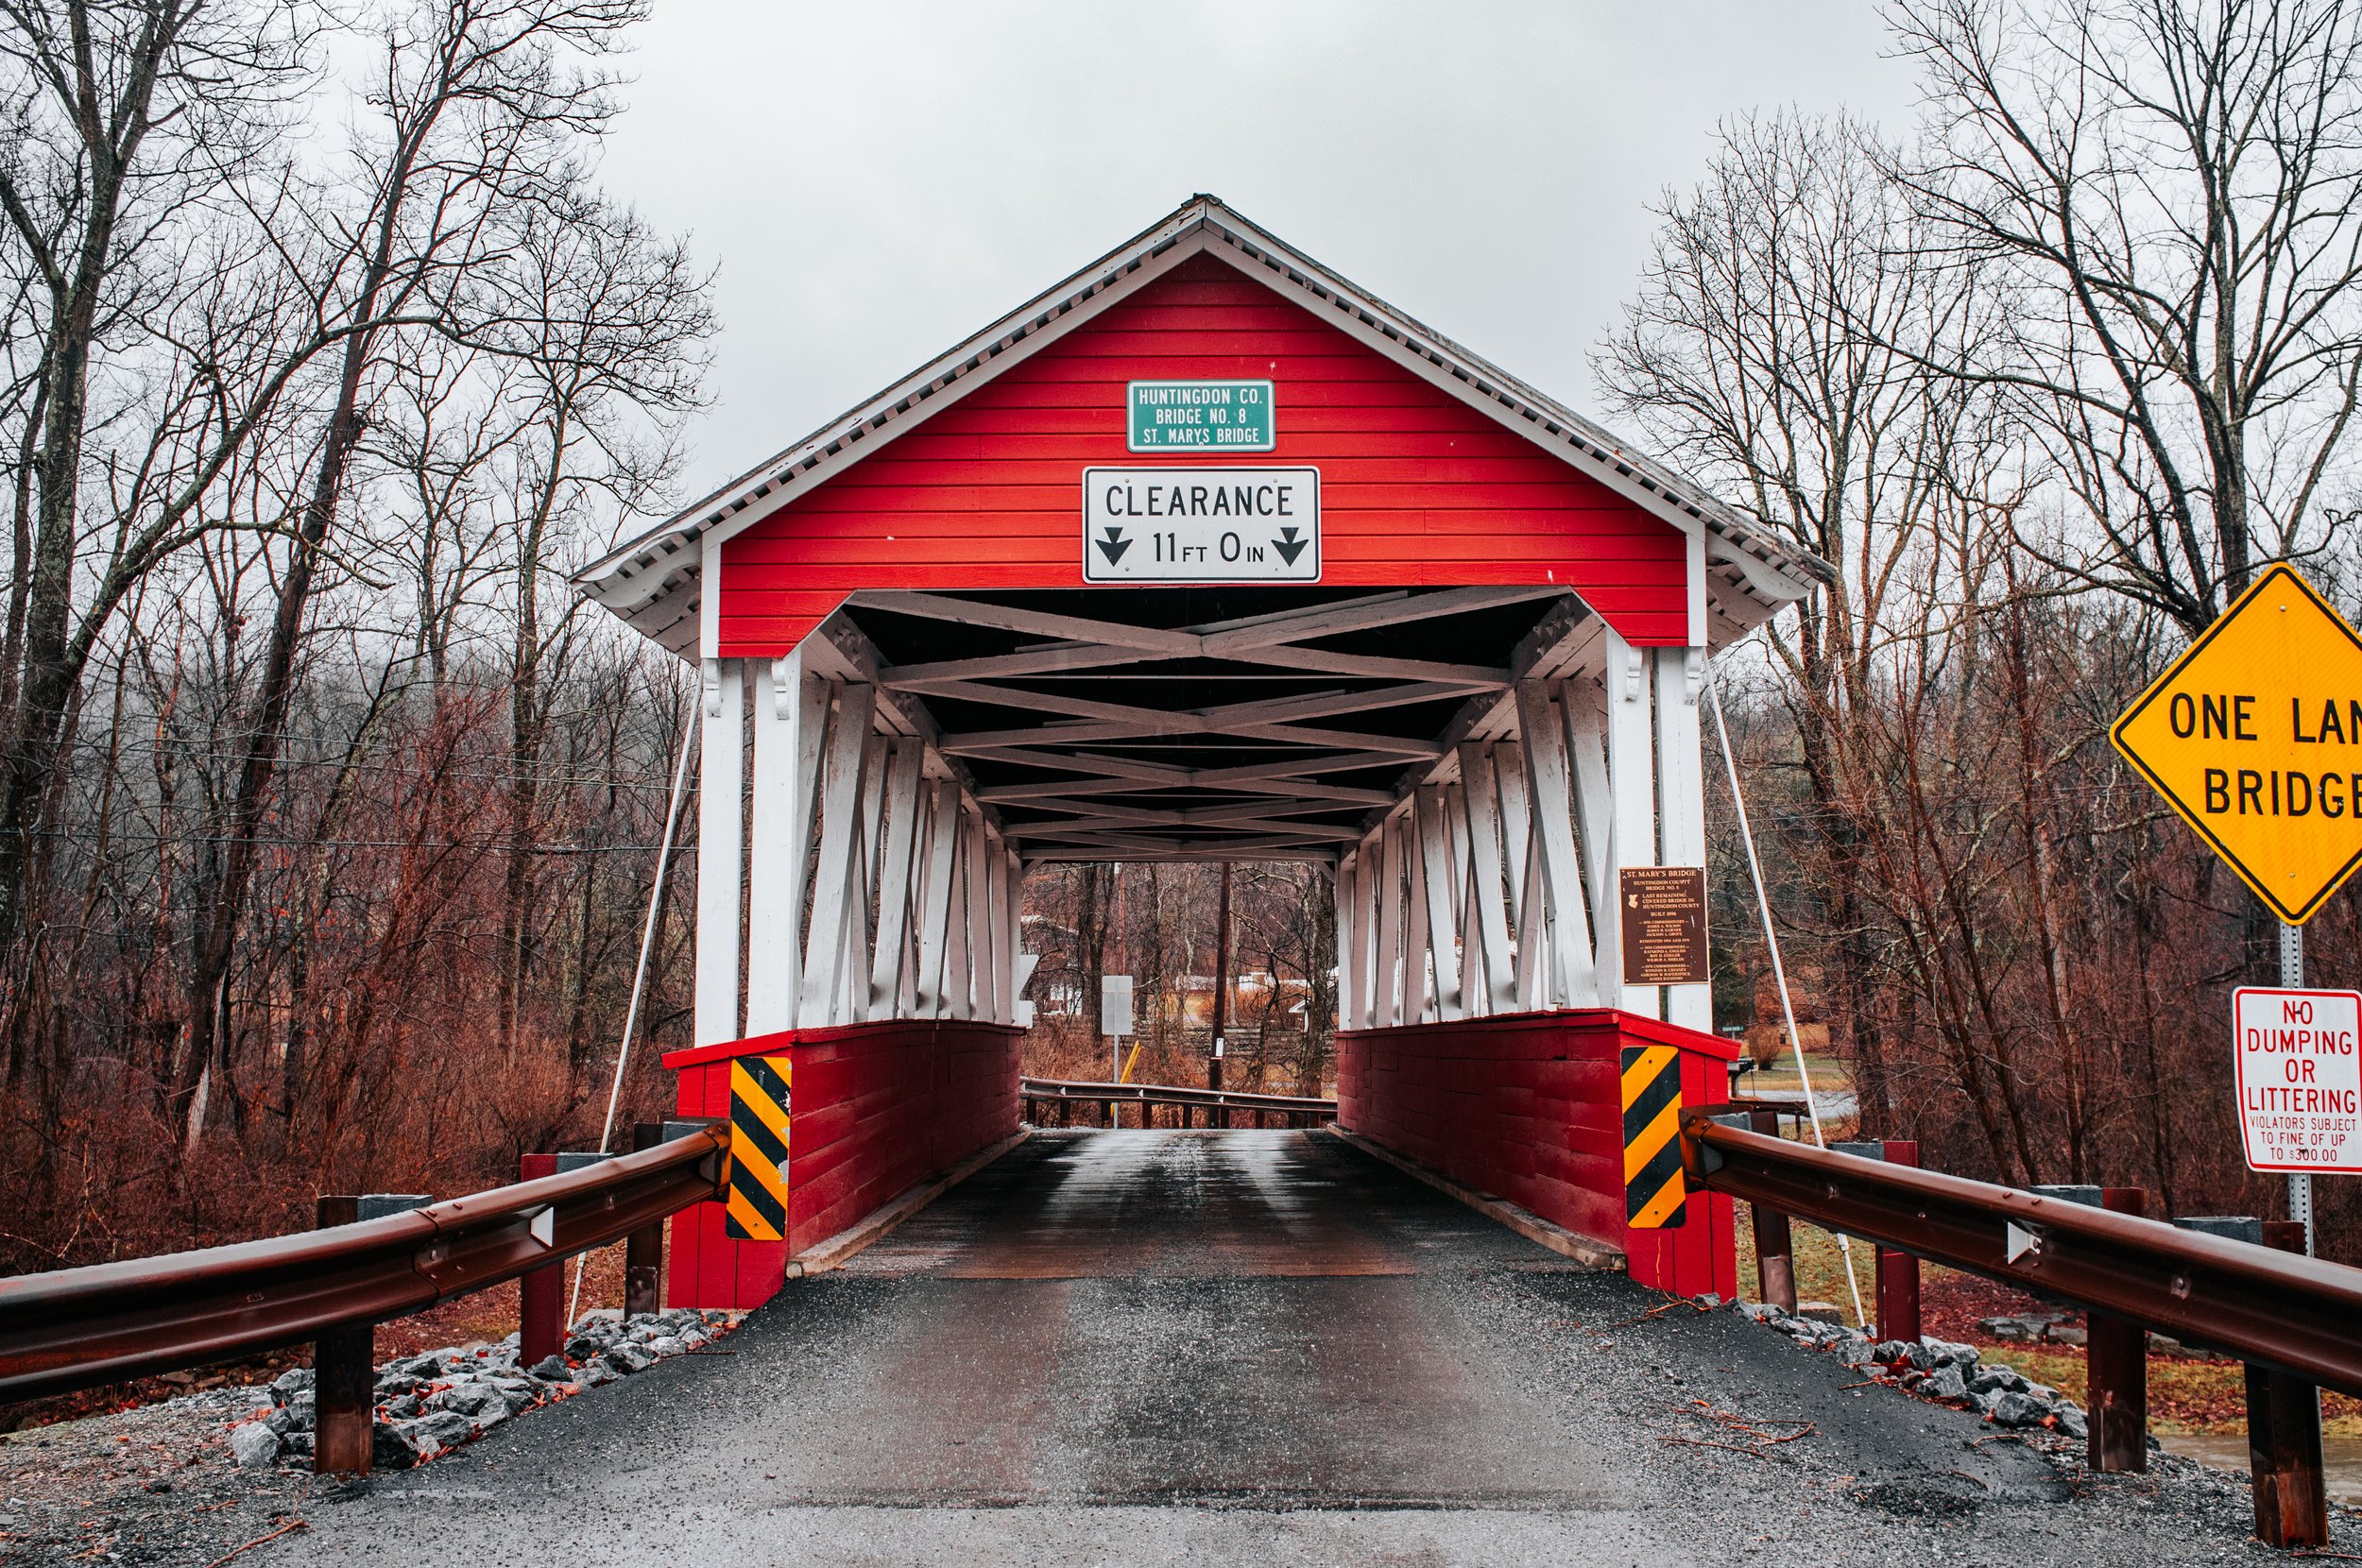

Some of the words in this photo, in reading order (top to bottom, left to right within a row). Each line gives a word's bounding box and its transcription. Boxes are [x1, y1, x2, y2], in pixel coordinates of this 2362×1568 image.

[1139, 388, 1231, 405] HUNTINGDON
[1240, 388, 1262, 404] CO.
[1155, 408, 1202, 424] BRIDGE
[1209, 408, 1231, 424] NO.
[1239, 408, 1246, 423] 8
[1143, 428, 1161, 443] ST.
[1168, 428, 1210, 443] MARYS
[1217, 428, 1259, 443] BRIDGE
[1105, 486, 1293, 517] CLEARANCE
[2170, 692, 2257, 741] ONE
[2284, 999, 2313, 1025] NO
[2248, 1028, 2352, 1055] DUMPING
[2285, 1058, 2316, 1083] OR
[2248, 1087, 2356, 1114] LITTERING
[2250, 1116, 2305, 1130] VIOLATORS
[2311, 1117, 2356, 1132] SUBJECT
[2261, 1132, 2274, 1145] TO
[2280, 1132, 2304, 1146] FINE
[2311, 1133, 2324, 1146] OF
[2331, 1133, 2346, 1146] UP
[2270, 1147, 2284, 1160] TO
[2289, 1148, 2337, 1162] $300.00
